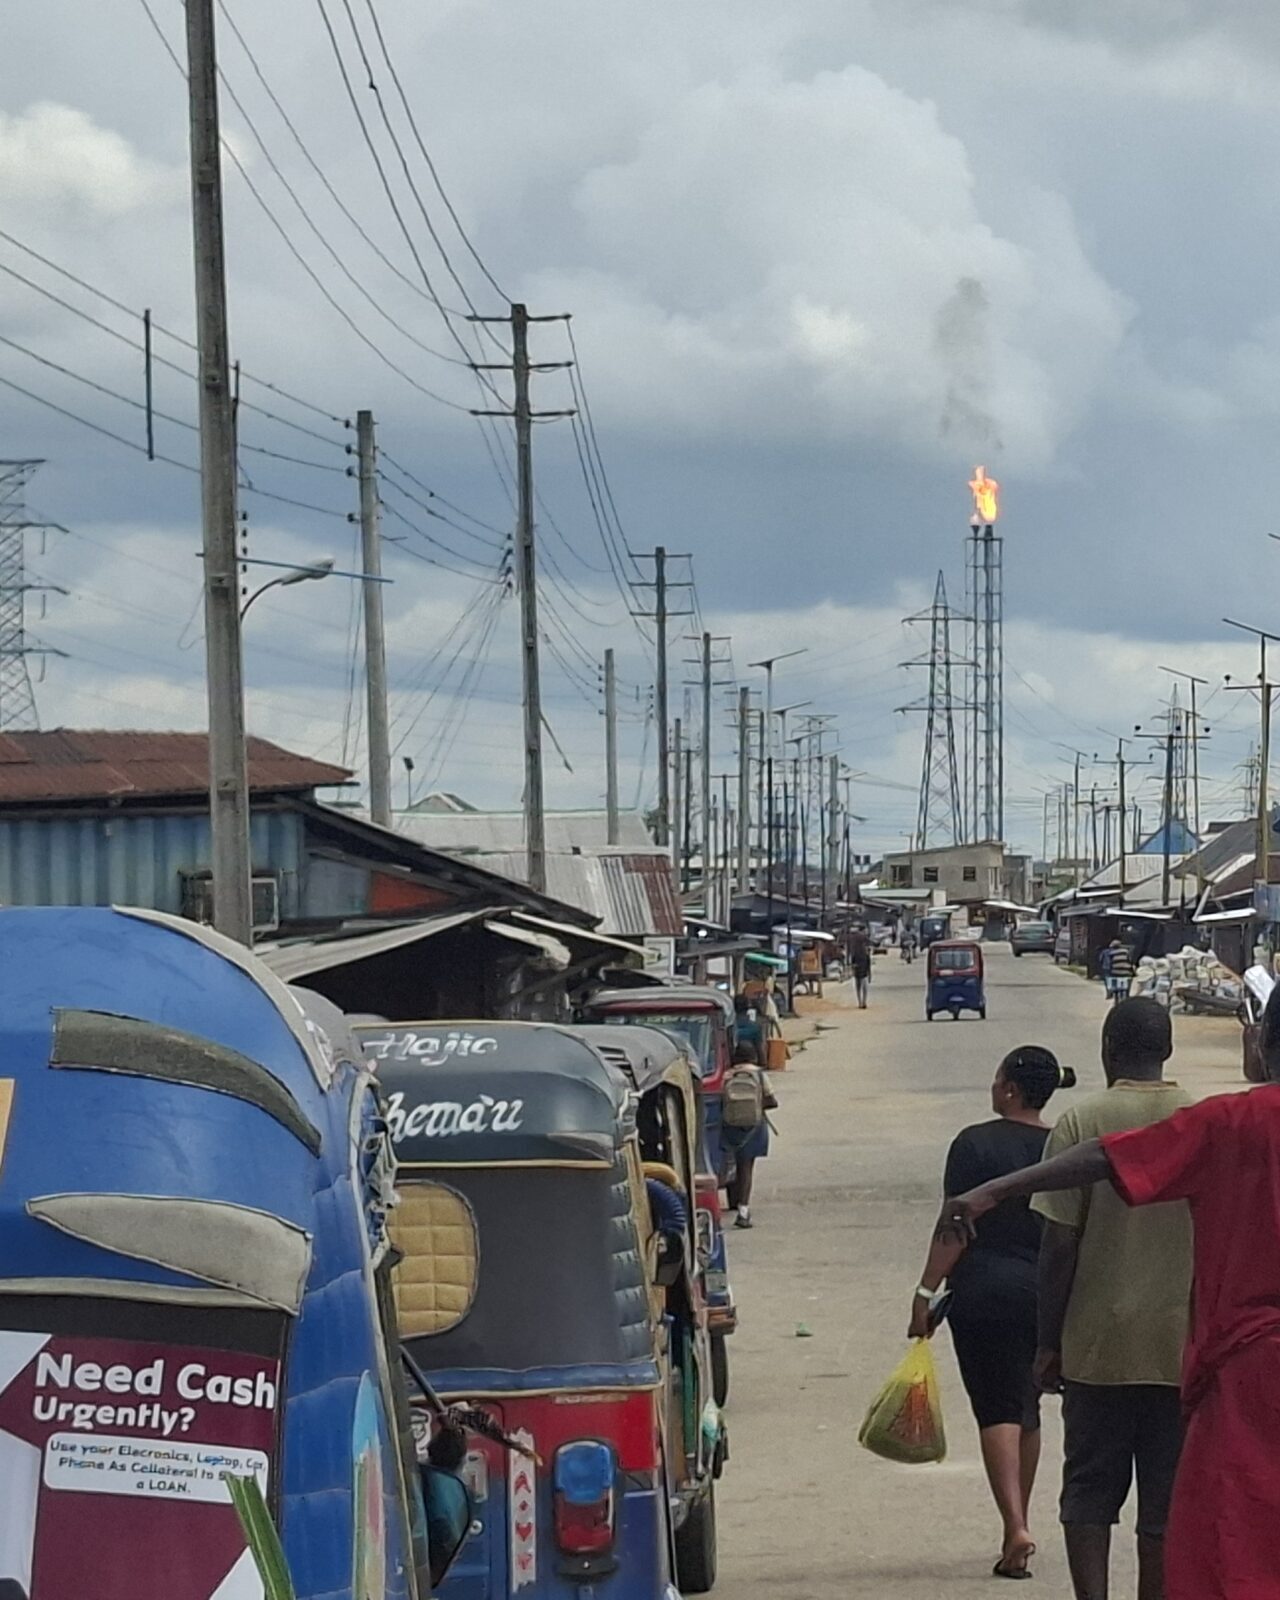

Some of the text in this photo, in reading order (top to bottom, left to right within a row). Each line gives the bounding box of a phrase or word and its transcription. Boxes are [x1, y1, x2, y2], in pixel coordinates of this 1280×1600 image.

[35, 1352, 276, 1409] Need Cash
[32, 1395, 196, 1436] Urgently?
[49, 1440, 77, 1452] Use
[80, 1444, 114, 1456] your
[58, 1456, 105, 1470] Phone
[108, 1460, 127, 1472] As
[135, 1480, 192, 1494] a LOAN.
